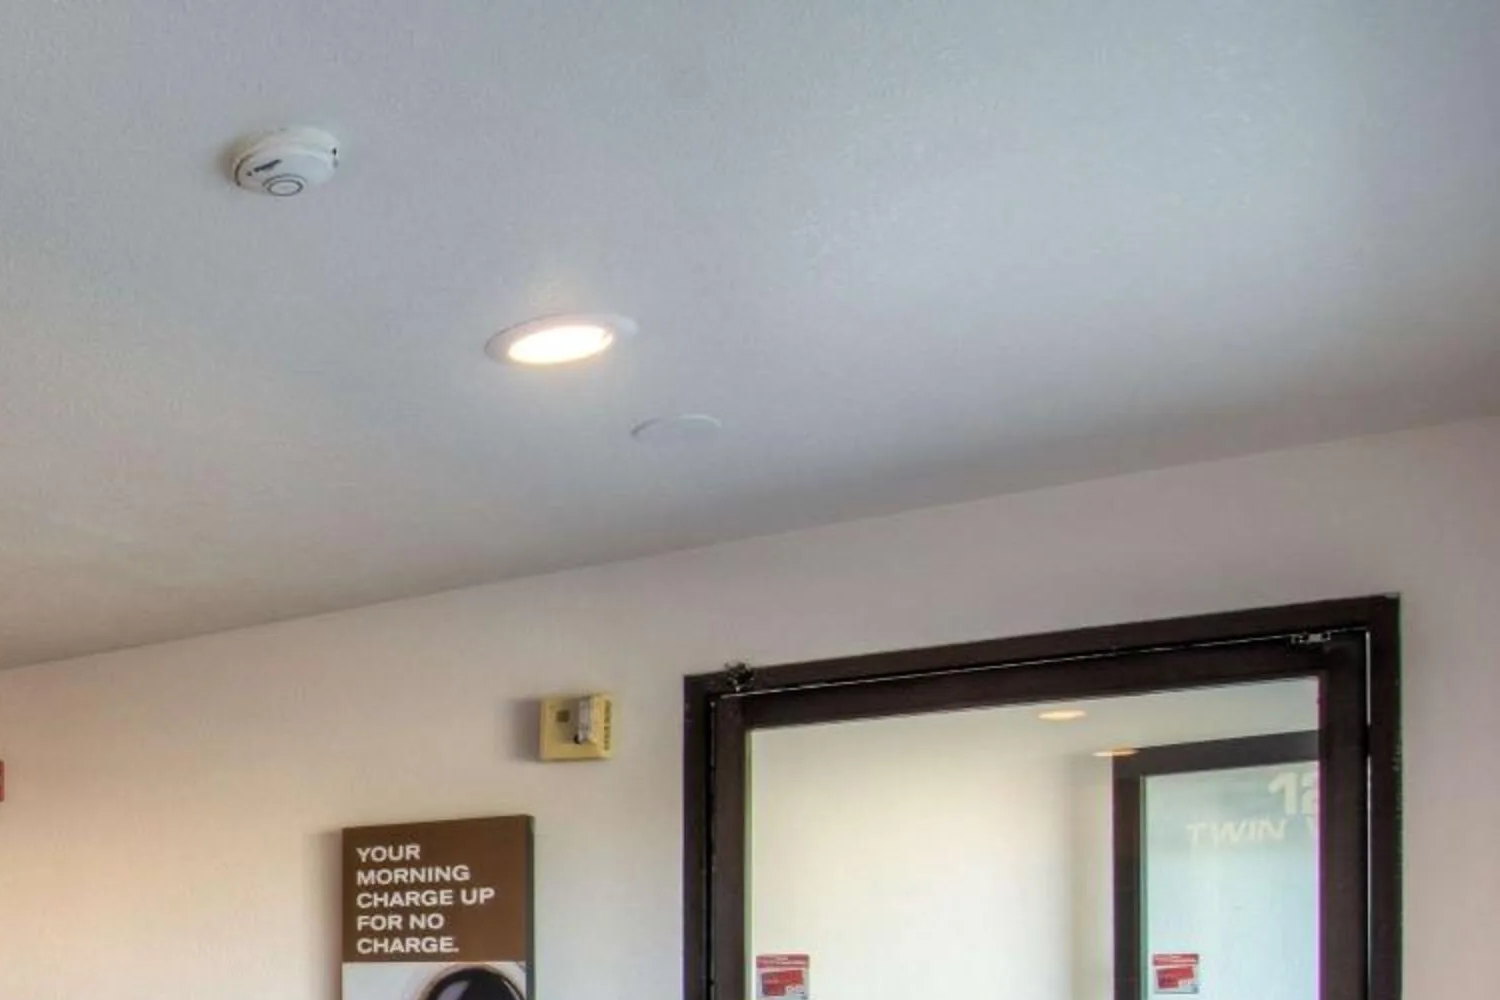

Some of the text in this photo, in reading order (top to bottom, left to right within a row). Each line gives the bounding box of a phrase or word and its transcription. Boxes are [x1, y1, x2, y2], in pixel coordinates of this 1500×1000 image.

[1186, 817, 1287, 845] TWIN
[356, 844, 421, 863] YOUR
[356, 864, 471, 886] MORNING
[356, 887, 496, 909] CHARGE UP
[357, 912, 445, 932] FOR NO
[356, 936, 460, 955] CHARGE.
